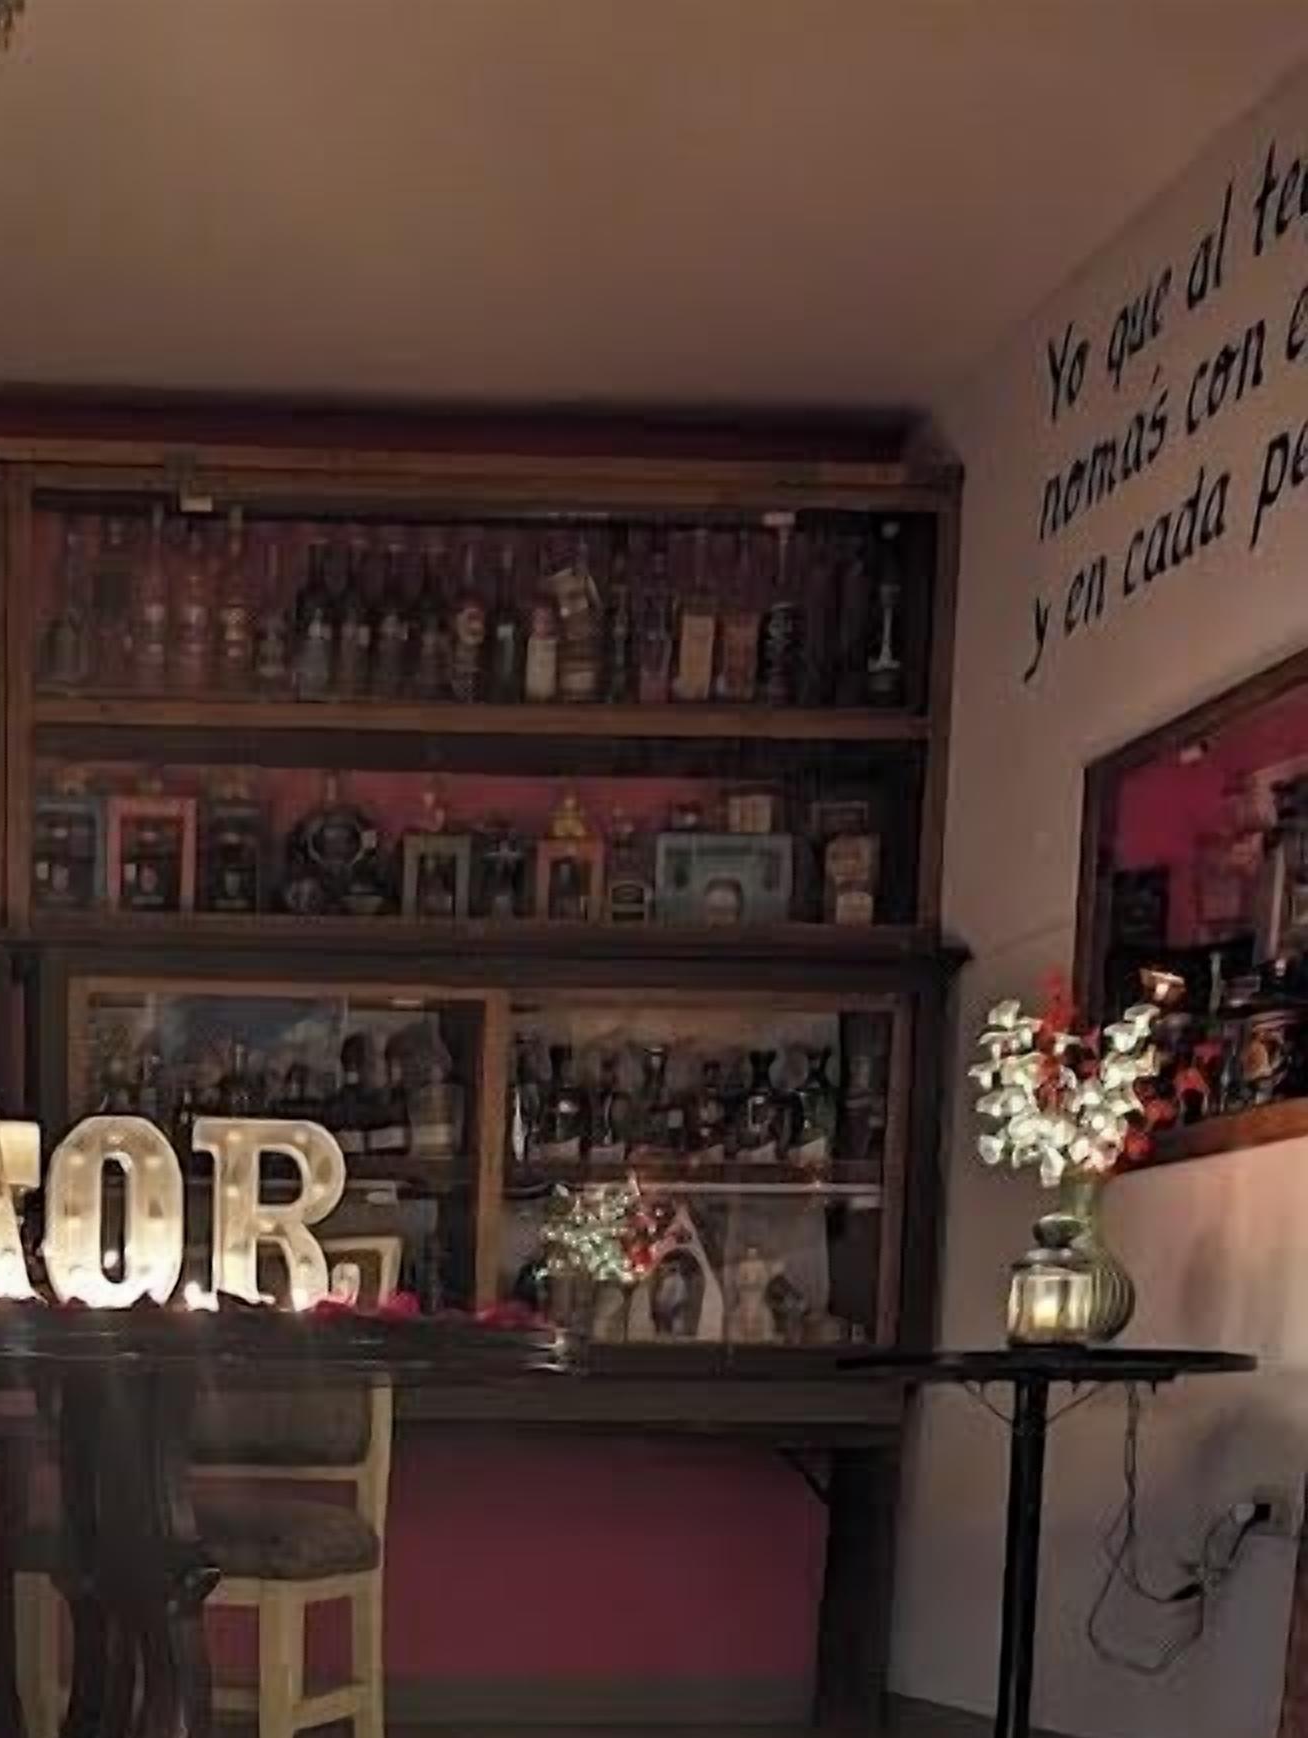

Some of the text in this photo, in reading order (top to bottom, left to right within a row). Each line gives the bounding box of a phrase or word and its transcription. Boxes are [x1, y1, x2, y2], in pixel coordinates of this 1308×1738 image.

[1047, 321, 1091, 423] Yo
[1106, 266, 1173, 392] que
[1185, 181, 1233, 312] al
[1039, 363, 1169, 543] nomás
[1185, 318, 1266, 437] con
[1023, 597, 1049, 684] y
[1063, 554, 1108, 637] en
[1122, 464, 1232, 599] cada
